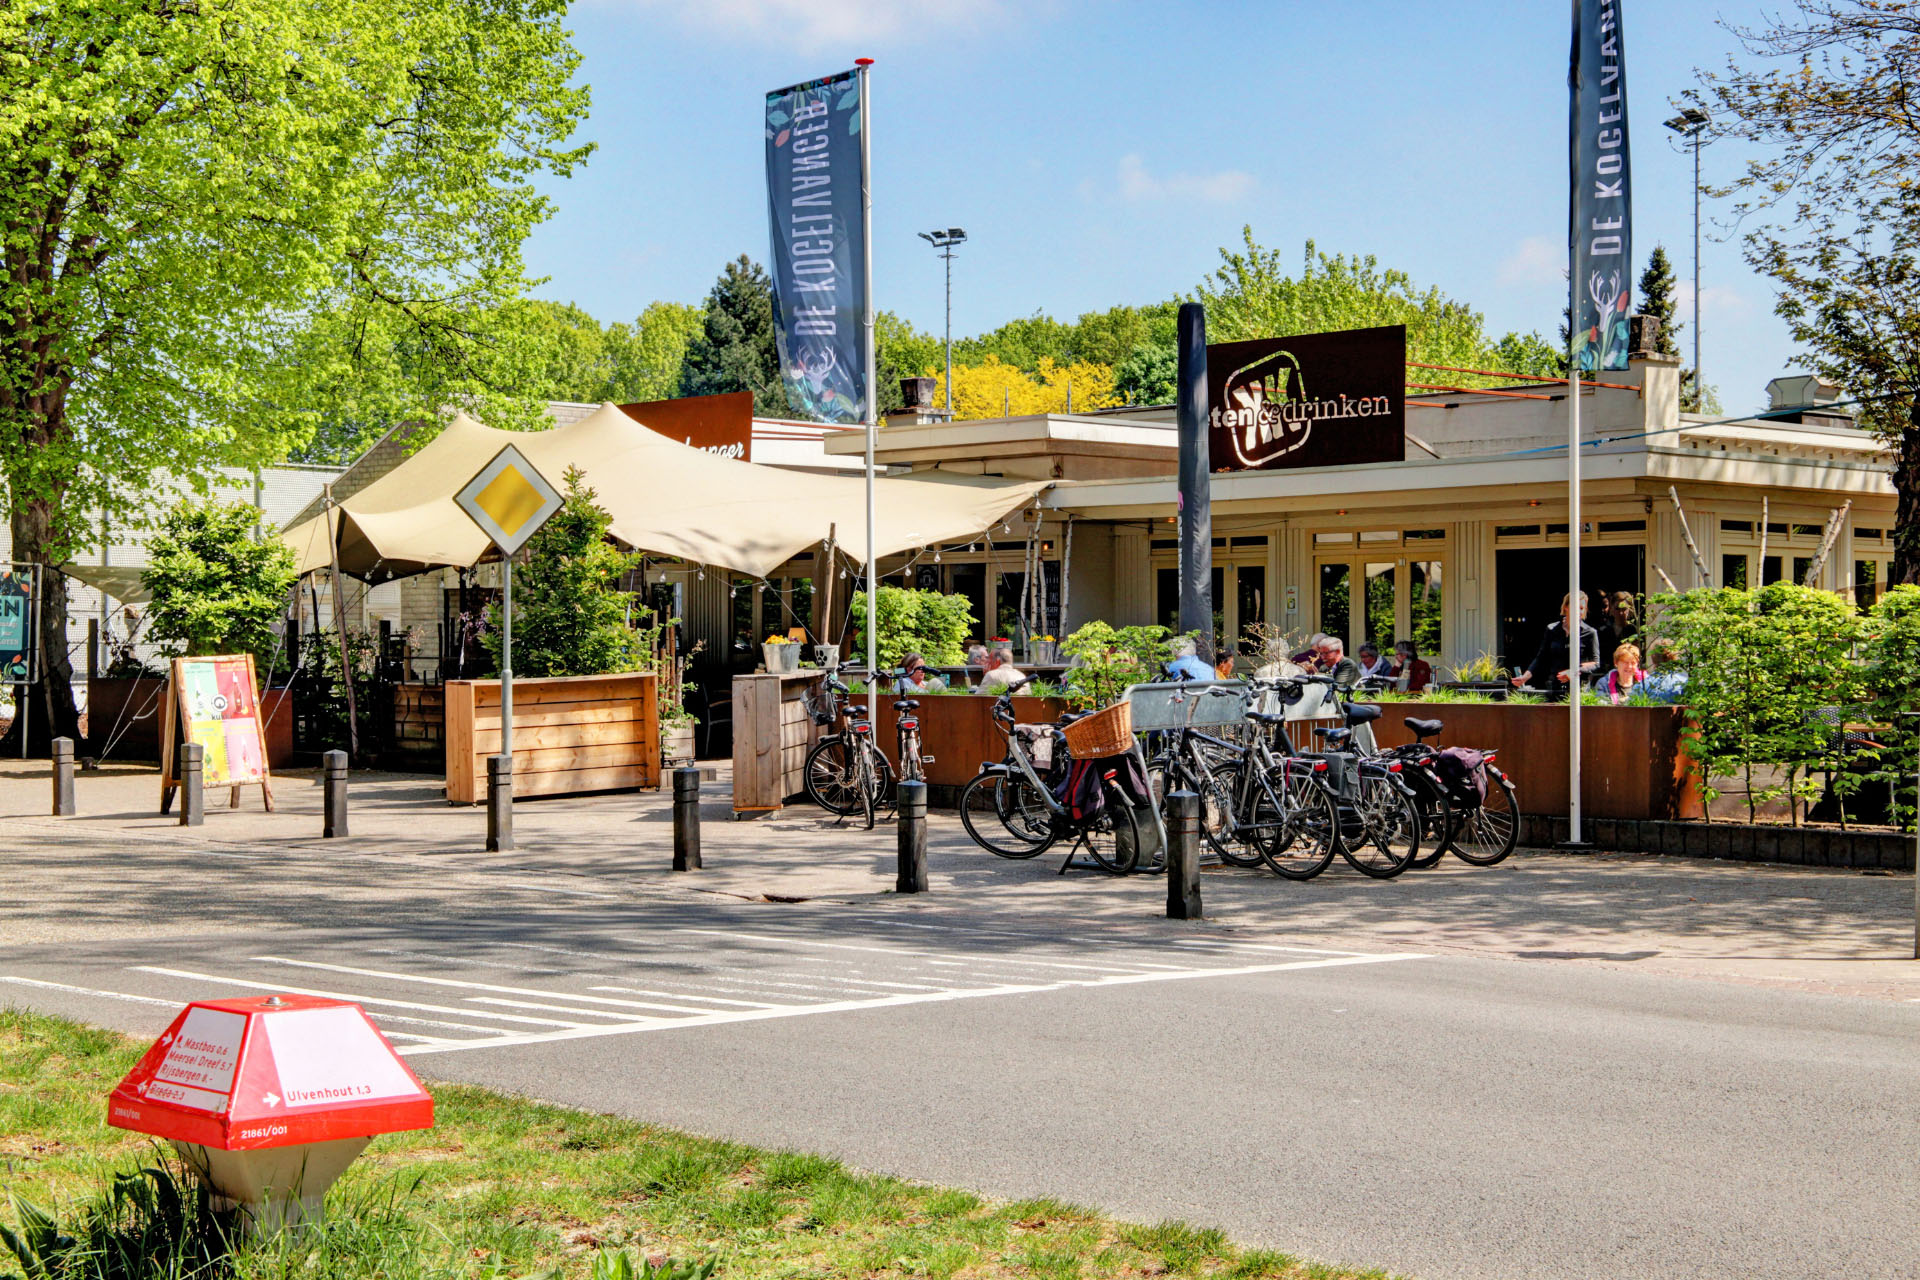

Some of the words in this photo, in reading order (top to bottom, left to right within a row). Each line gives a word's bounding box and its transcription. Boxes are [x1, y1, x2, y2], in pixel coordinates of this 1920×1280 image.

[1594, 0, 1624, 199] KOGELVAN
[1590, 215, 1624, 257] DE
[1208, 403, 1254, 428] ten
[0, 599, 20, 617] N
[184, 1037, 216, 1054] Mastbos
[167, 1050, 198, 1065] Meersel
[197, 1056, 220, 1070] Dreef
[161, 1064, 202, 1082] Rijsbergen
[287, 1086, 354, 1102] Ulvenhout
[356, 1085, 372, 1096] 1.3
[240, 1125, 288, 1140] 21861/001
